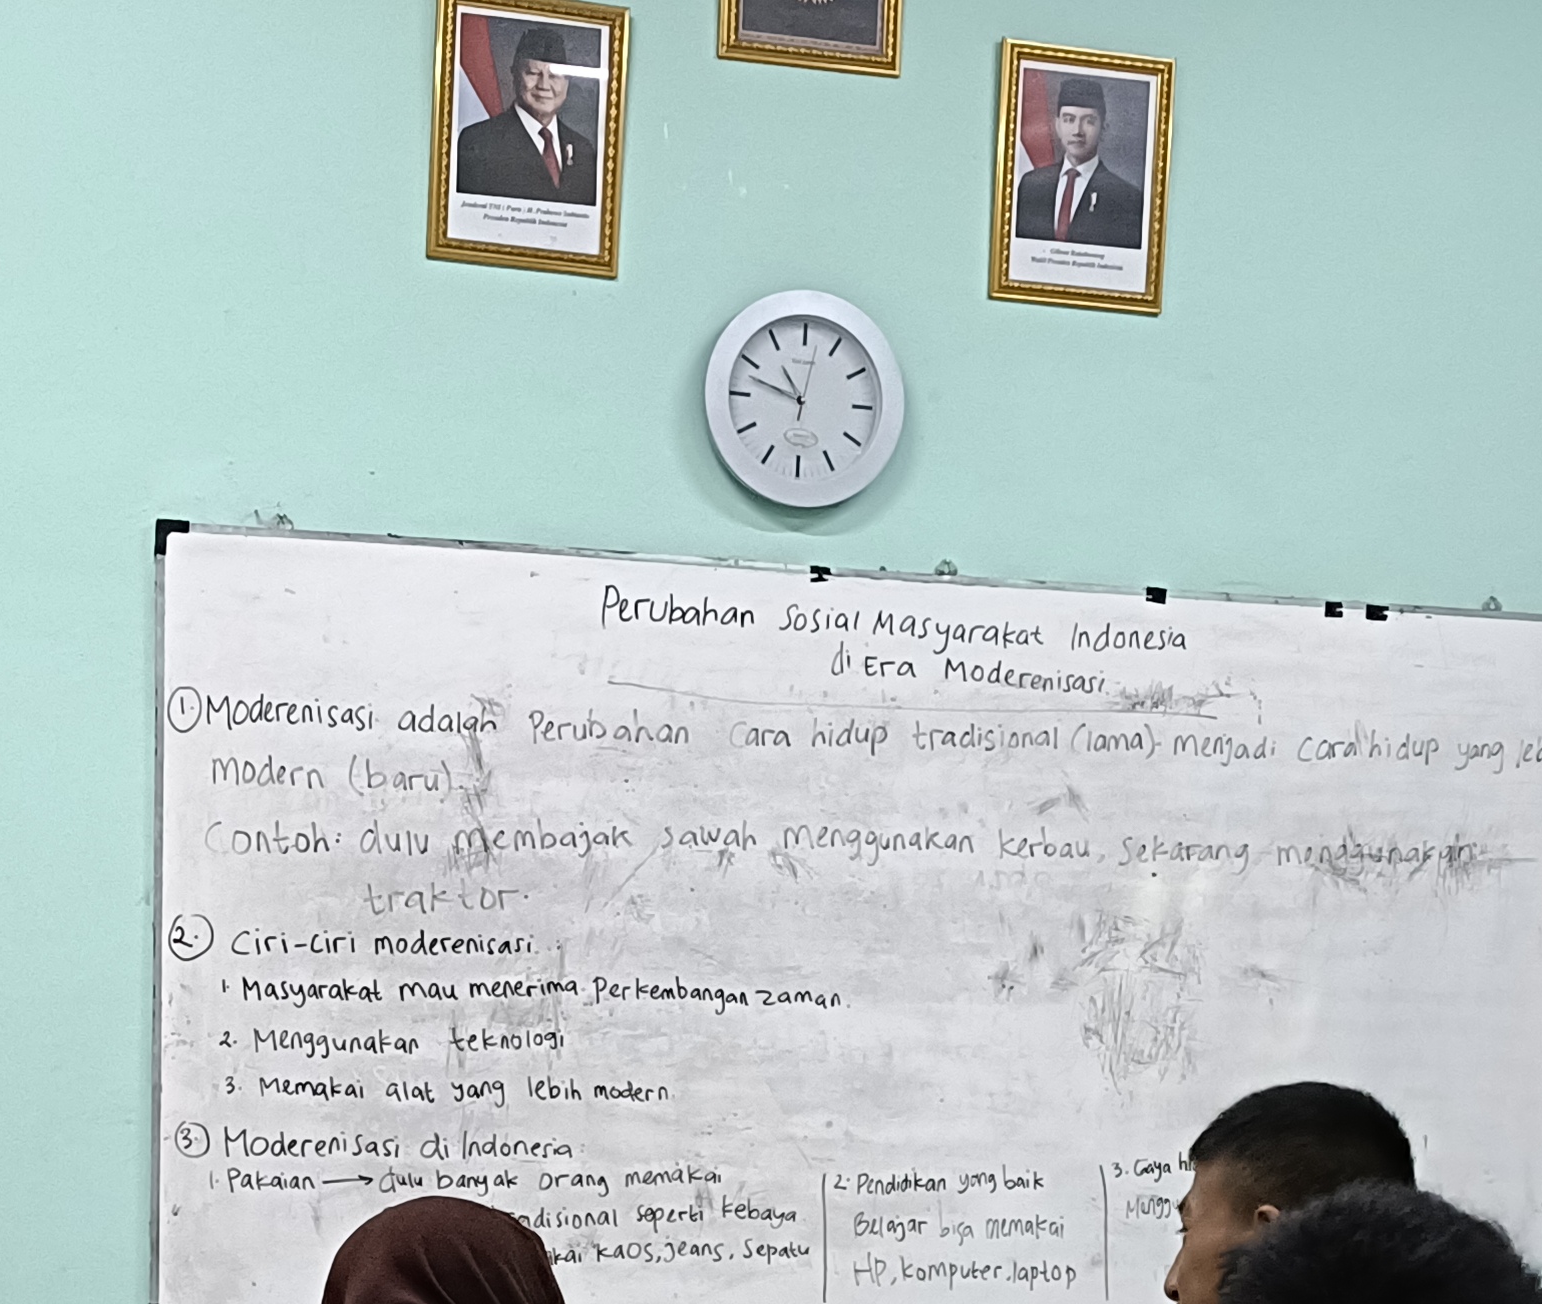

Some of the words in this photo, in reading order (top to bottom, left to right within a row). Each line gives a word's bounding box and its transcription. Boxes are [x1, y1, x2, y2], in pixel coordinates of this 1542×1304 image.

[601, 585, 755, 629] Perubahan
[779, 603, 859, 633] Sosial
[873, 609, 1044, 654] Masyarakat
[1071, 623, 1187, 652] Indonesia
[831, 641, 852, 677] di
[864, 656, 918, 679] Era
[397, 700, 497, 734] adalah
[529, 708, 690, 746] Perubahan
[811, 721, 889, 755] hidup
[913, 720, 1059, 752] tradisional
[1369, 729, 1440, 766] hidup
[1455, 742, 1505, 774] yang
[360, 819, 429, 856] dulu
[242, 976, 384, 1007] Masyarakat
[398, 979, 459, 1001] mau
[468, 978, 579, 1000] menerima
[252, 1028, 420, 1059] Menggunakan
[449, 1024, 566, 1052] teknologi
[259, 1075, 365, 1099] Memakai
[385, 1076, 435, 1103] alat
[451, 1079, 506, 1107] yang
[527, 1074, 582, 1100] lebih
[419, 1126, 450, 1159] di
[227, 1166, 317, 1192] Pakaian
[436, 1169, 519, 1196] banyak
[625, 1166, 723, 1188] memakai
[856, 1168, 947, 1195] Pendidikan
[958, 1171, 998, 1194] yang
[1003, 1164, 1045, 1190] baik
[1133, 1158, 1172, 1182] Gaya
[636, 1203, 705, 1233] seperti
[721, 1194, 798, 1229] kebaya
